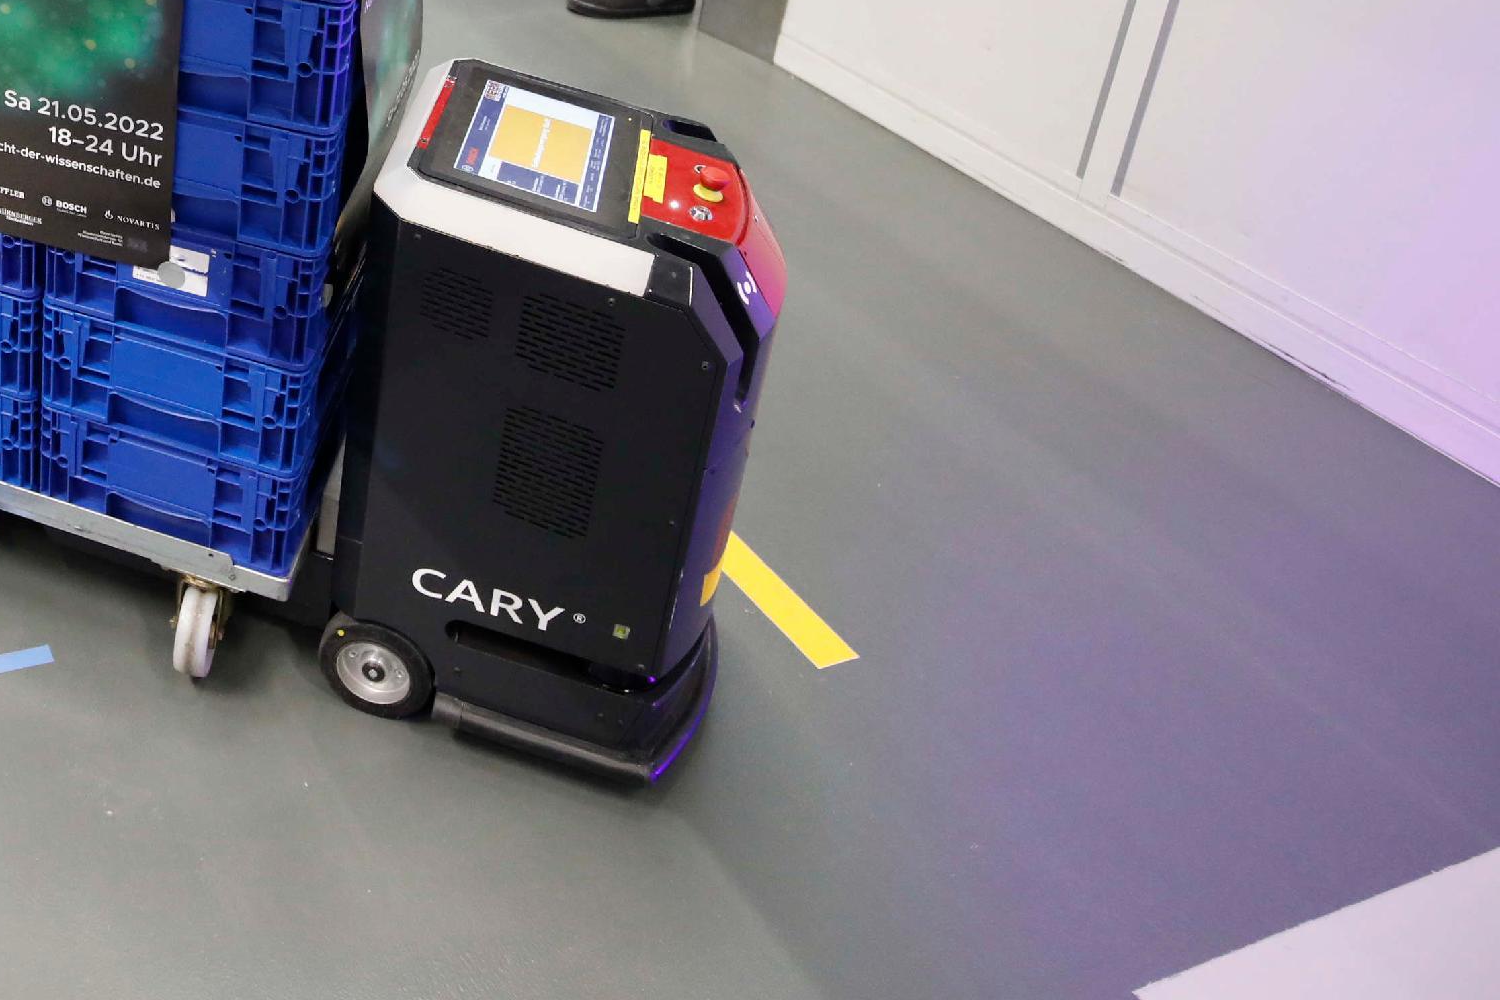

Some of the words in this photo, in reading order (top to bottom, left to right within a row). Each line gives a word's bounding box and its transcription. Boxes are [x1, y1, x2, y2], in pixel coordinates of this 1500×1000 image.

[4, 89, 30, 110] Sa
[37, 97, 163, 140] 21.05.2022
[121, 142, 162, 167] Uhr
[56, 200, 86, 213] BOSCH
[117, 215, 159, 229] NOVARTIS
